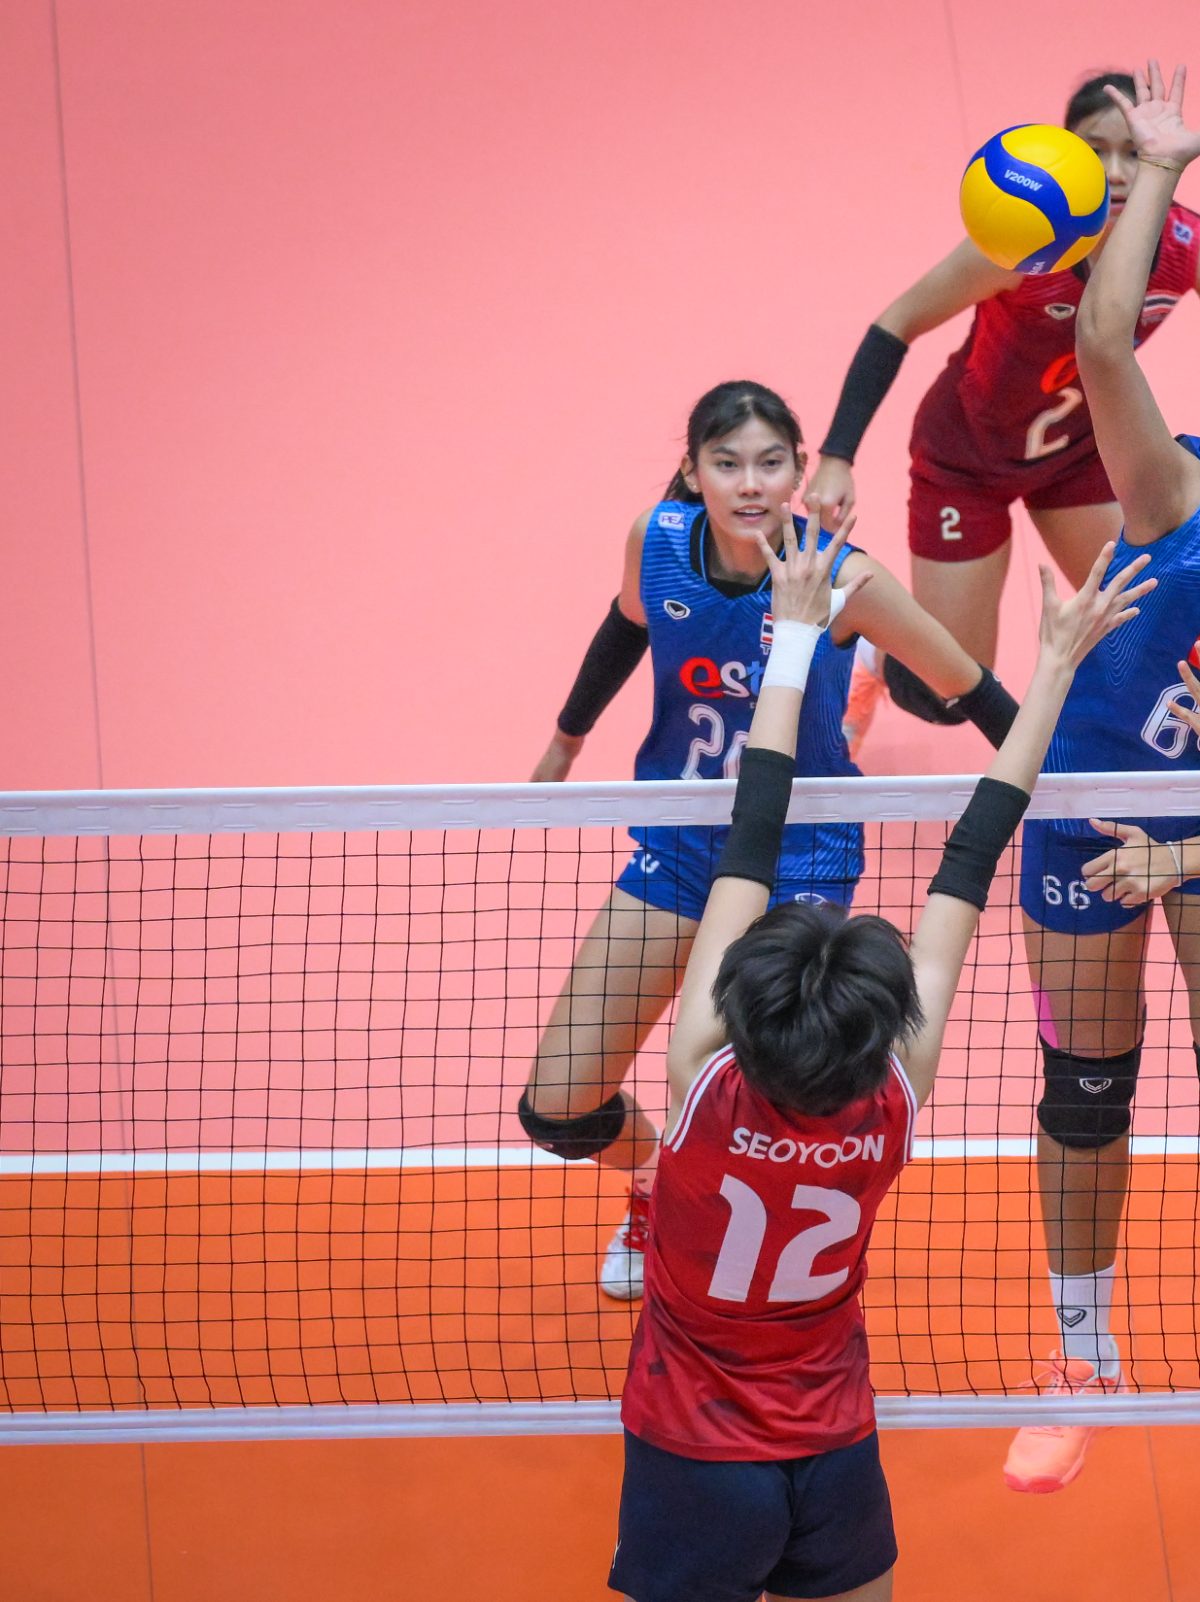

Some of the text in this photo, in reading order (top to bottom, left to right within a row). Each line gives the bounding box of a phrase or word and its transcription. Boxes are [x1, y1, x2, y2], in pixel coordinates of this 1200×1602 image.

[1003, 169, 1043, 192] V200W
[1024, 386, 1083, 460] 2
[940, 506, 962, 540] 2
[679, 656, 765, 697] est
[1043, 875, 1090, 910] 66
[728, 1127, 885, 1169] SEOYOON
[707, 1173, 861, 1303] 12
